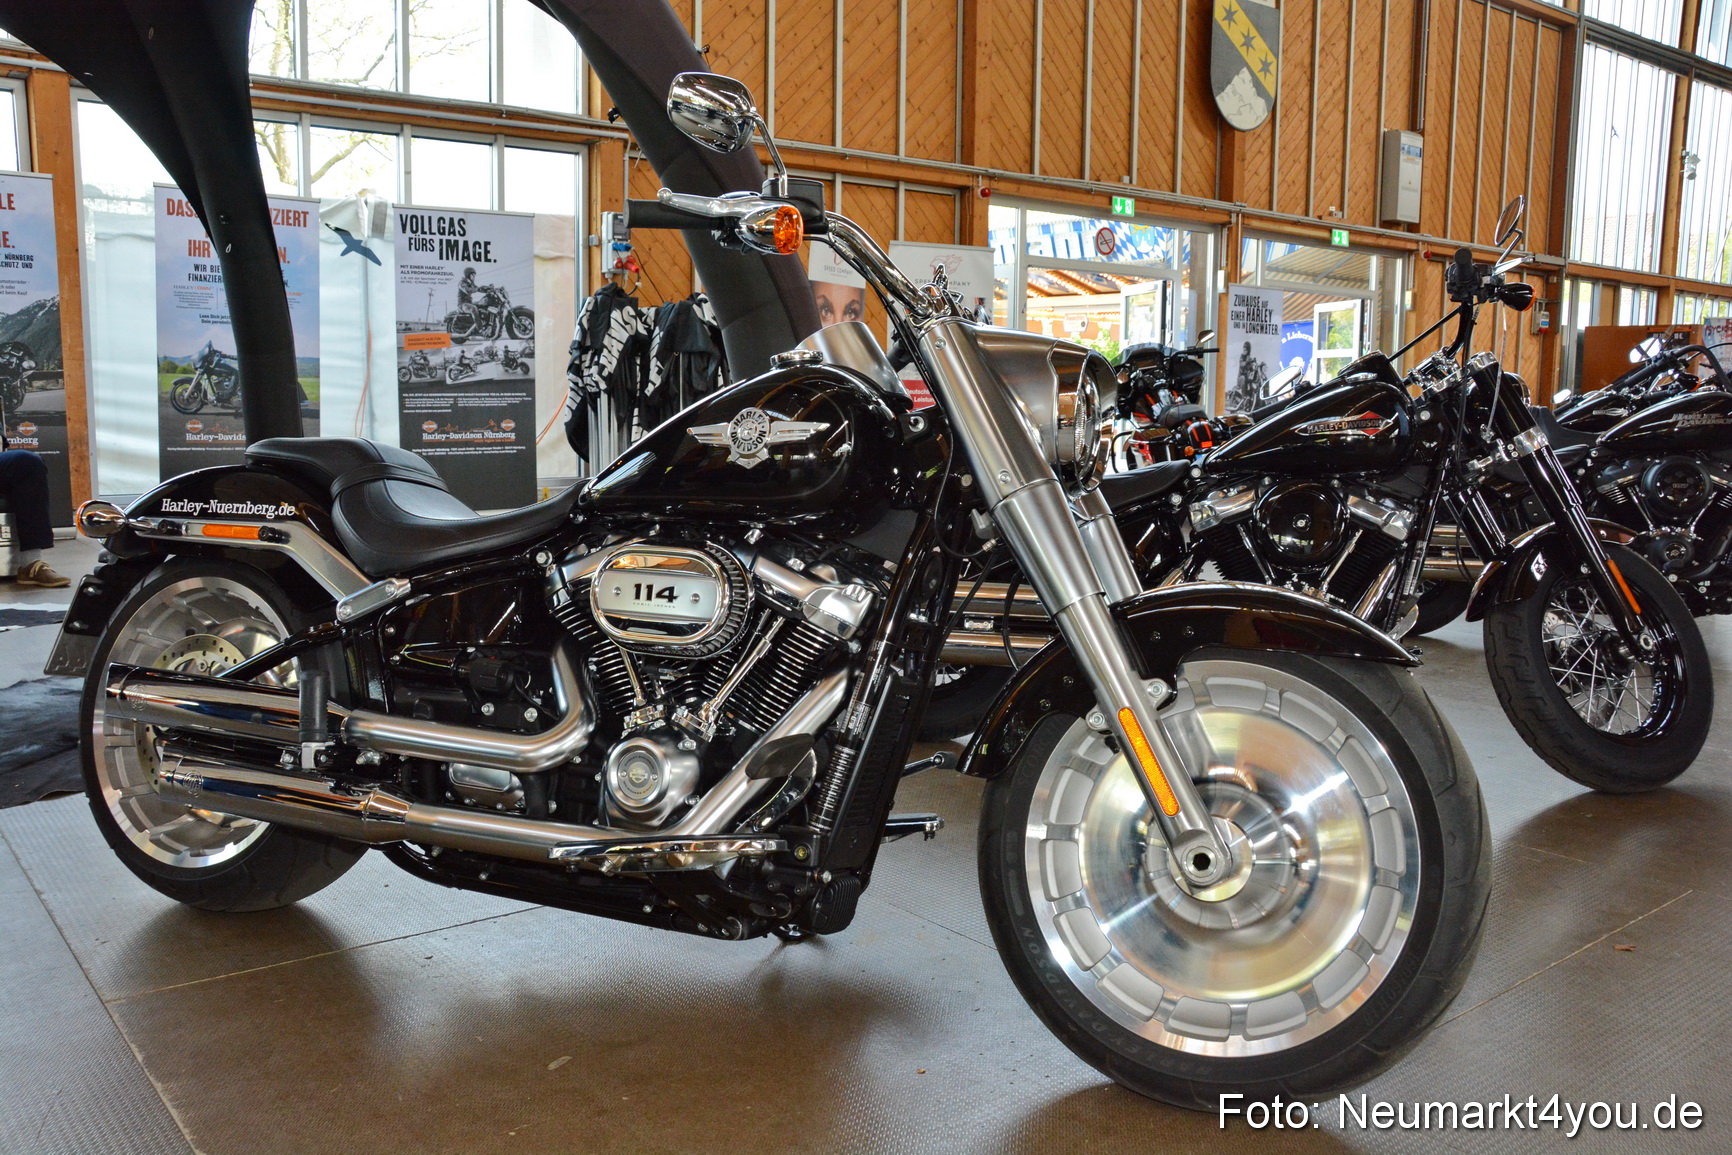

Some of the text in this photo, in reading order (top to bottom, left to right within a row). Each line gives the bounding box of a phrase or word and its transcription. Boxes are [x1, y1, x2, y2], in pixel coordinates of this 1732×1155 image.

[399, 213, 467, 237] VOLLGAS
[4, 252, 34, 261] NÜRNBERG
[187, 239, 211, 258] IHR
[408, 234, 498, 264] FÜRS IMAGE.
[193, 263, 207, 273] WIR
[1233, 294, 1261, 308] ZUHAUSE
[1230, 307, 1274, 323] EINER HARLEY
[733, 410, 767, 427] HARLEY
[1306, 419, 1383, 433] HARLEY-DAVIDSON
[422, 432, 483, 441] Harley-Davidson
[483, 431, 516, 440] Nürnberg
[730, 429, 767, 452] DAVIDSON
[161, 498, 296, 519] Harley-Nuernberg.de
[633, 583, 680, 603] 114
